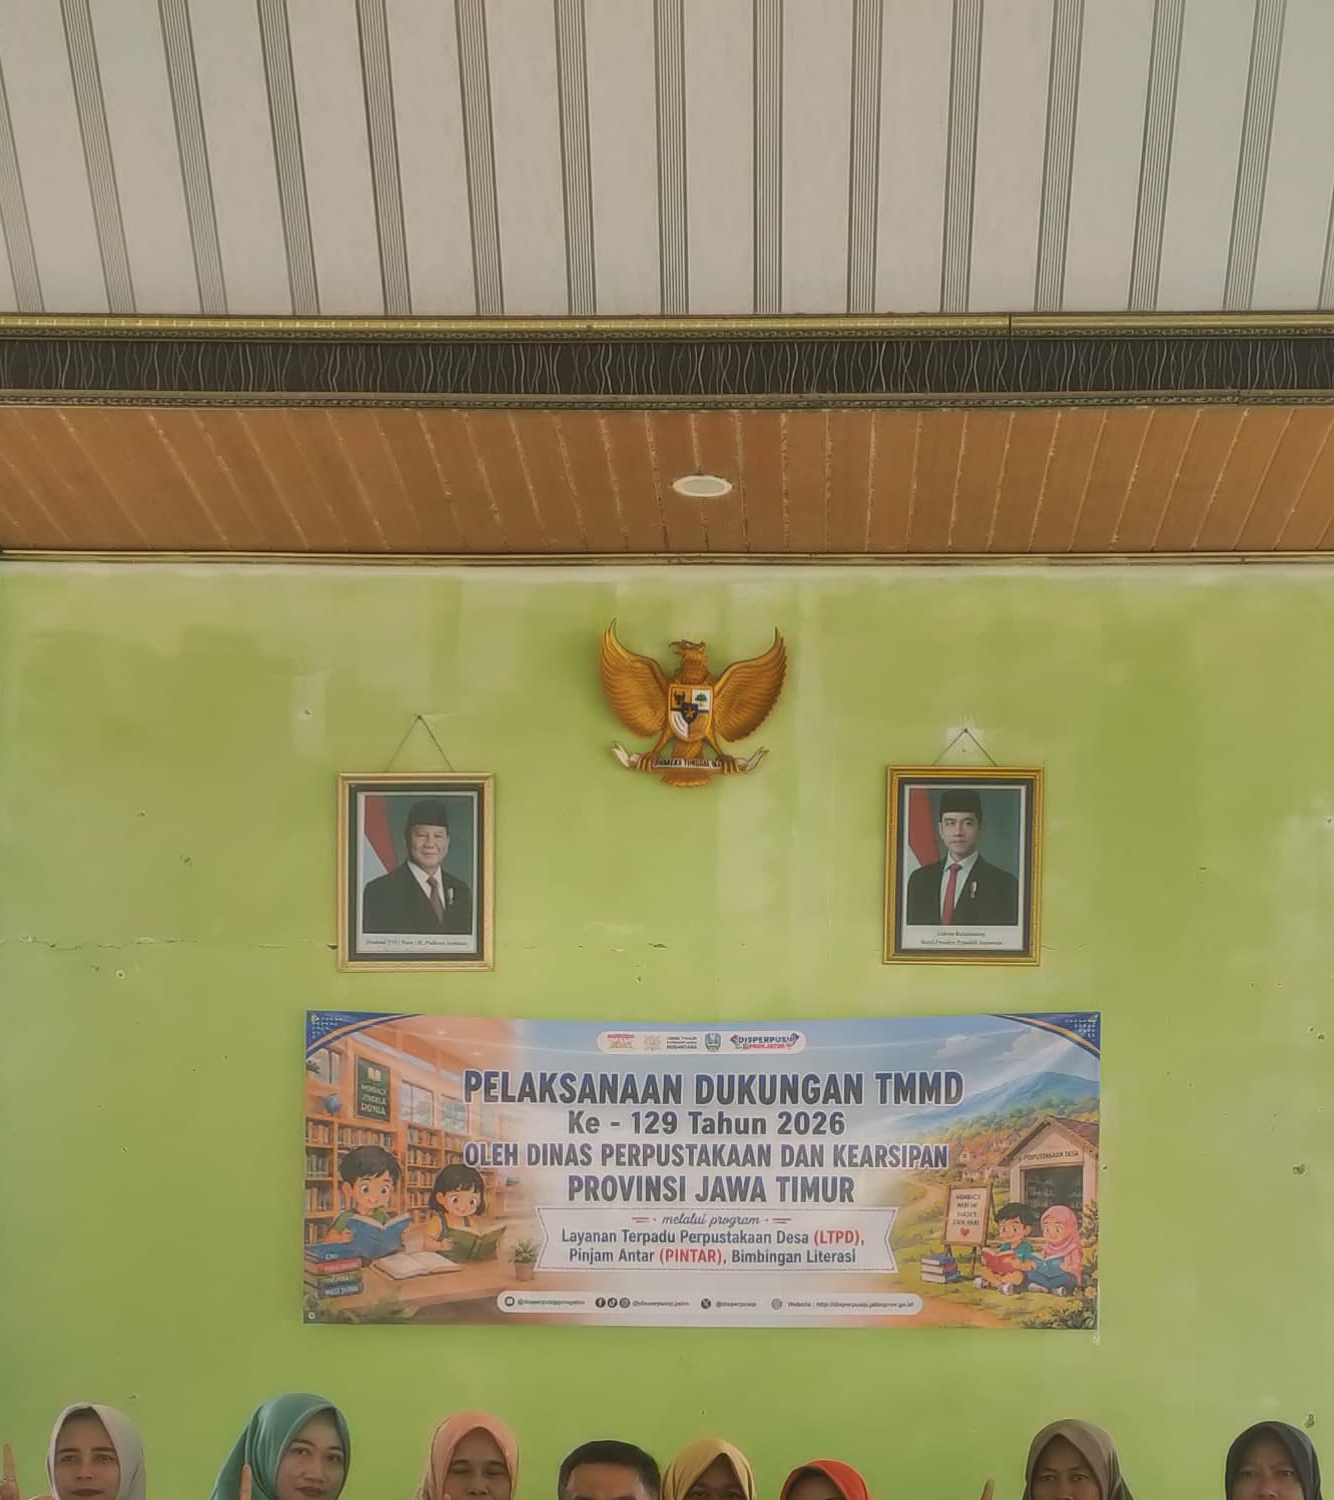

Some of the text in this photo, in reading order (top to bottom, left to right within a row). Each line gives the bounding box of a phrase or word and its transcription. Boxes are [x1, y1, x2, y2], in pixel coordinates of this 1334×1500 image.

[465, 1070, 964, 1105] PELAKSANAAN DUKUNGAN TMMD
[568, 1111, 600, 1134] Ke
[631, 1111, 678, 1135] 129
[688, 1111, 767, 1135] Tahun
[777, 1111, 845, 1135] 2026
[465, 1143, 948, 1168] OLEH DINAS PERPUSTAKAAN DAN KEARSIPAN
[568, 1175, 855, 1203] PROVINSI JAWA TIMUR
[662, 1212, 761, 1229] melalui program
[562, 1228, 865, 1250] Layanan Terpadu Perpustakaan Desa (LTPD),
[569, 1248, 856, 1266] Pinjam Antar (PINTAR), Bimbingan Literasi
